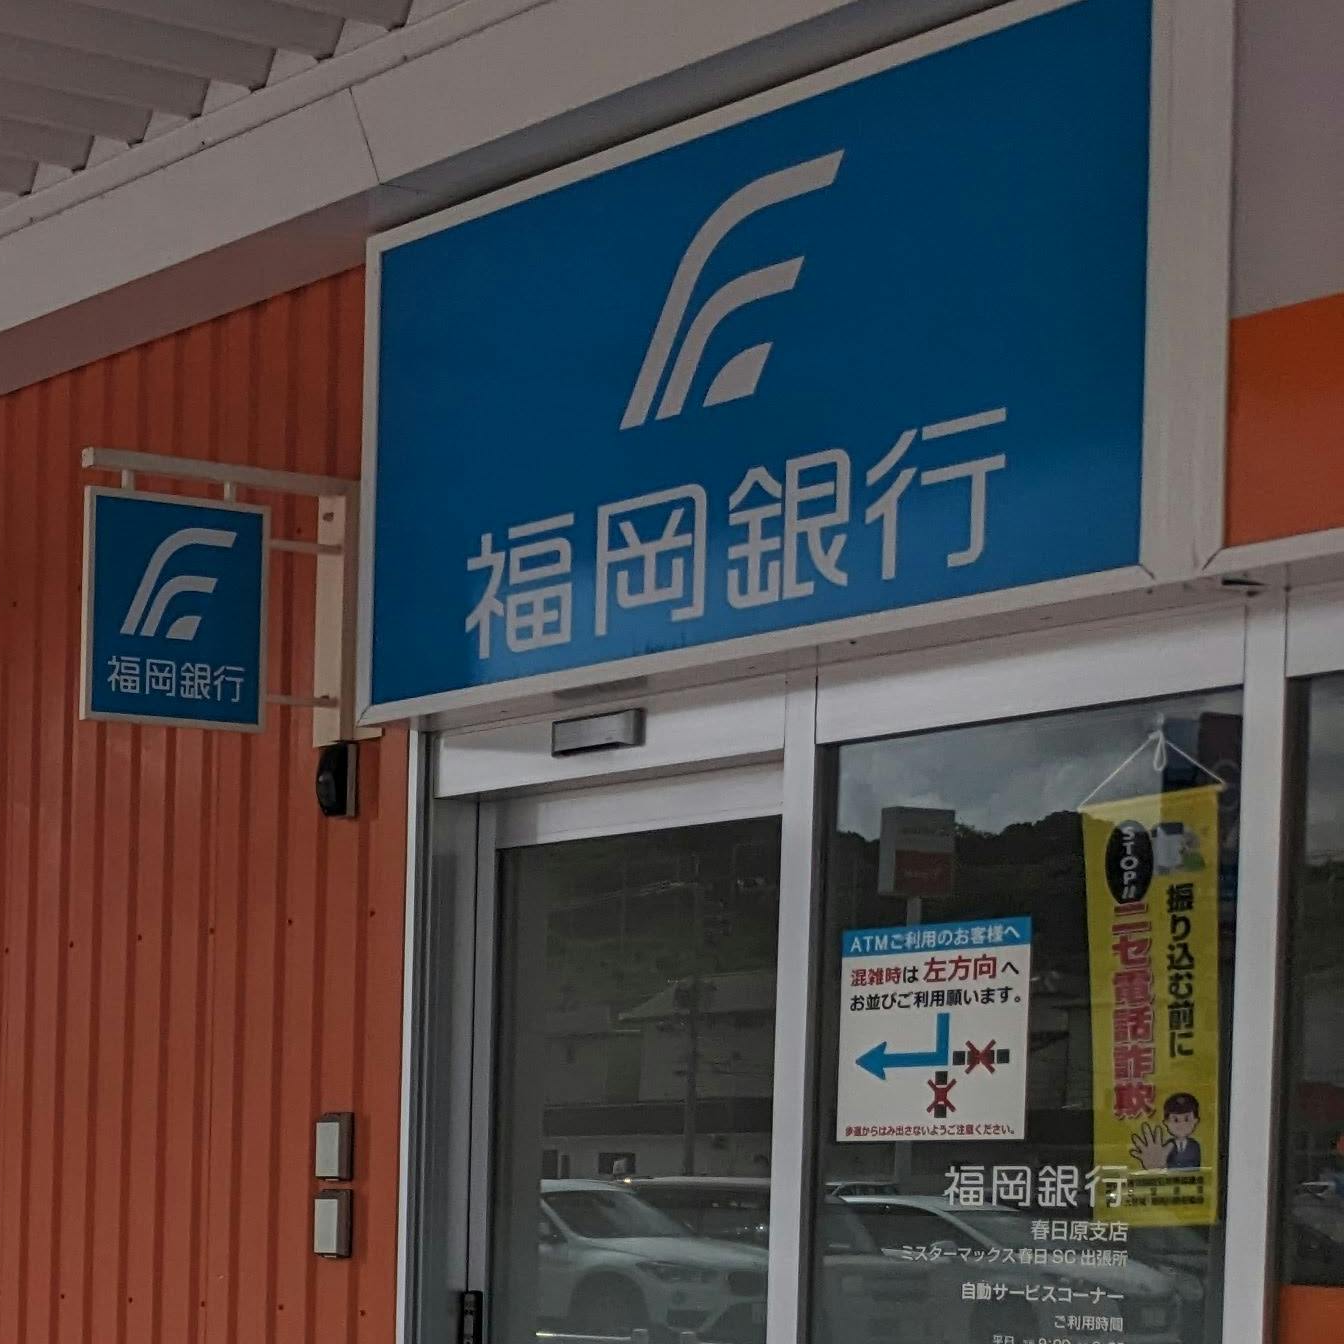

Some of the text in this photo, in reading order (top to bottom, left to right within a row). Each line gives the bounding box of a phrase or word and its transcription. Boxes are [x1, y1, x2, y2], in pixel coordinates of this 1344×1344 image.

[464, 406, 1007, 660] 福岡銀行
[107, 655, 245, 703] 福岡銀行
[850, 925, 1021, 953] ATMご利用のお客様へ
[1165, 883, 1196, 1058] 振り込む前に
[850, 986, 1022, 1011] お並びご利用願います。
[1112, 901, 1157, 1119] ニセ電話詐欺
[944, 1165, 1128, 1208] 福岡銀行
[1031, 1220, 1129, 1242] 春日原支店
[962, 1281, 1124, 1304] 自動サービスコーナー
[1054, 1315, 1124, 1332] ご利用時間
